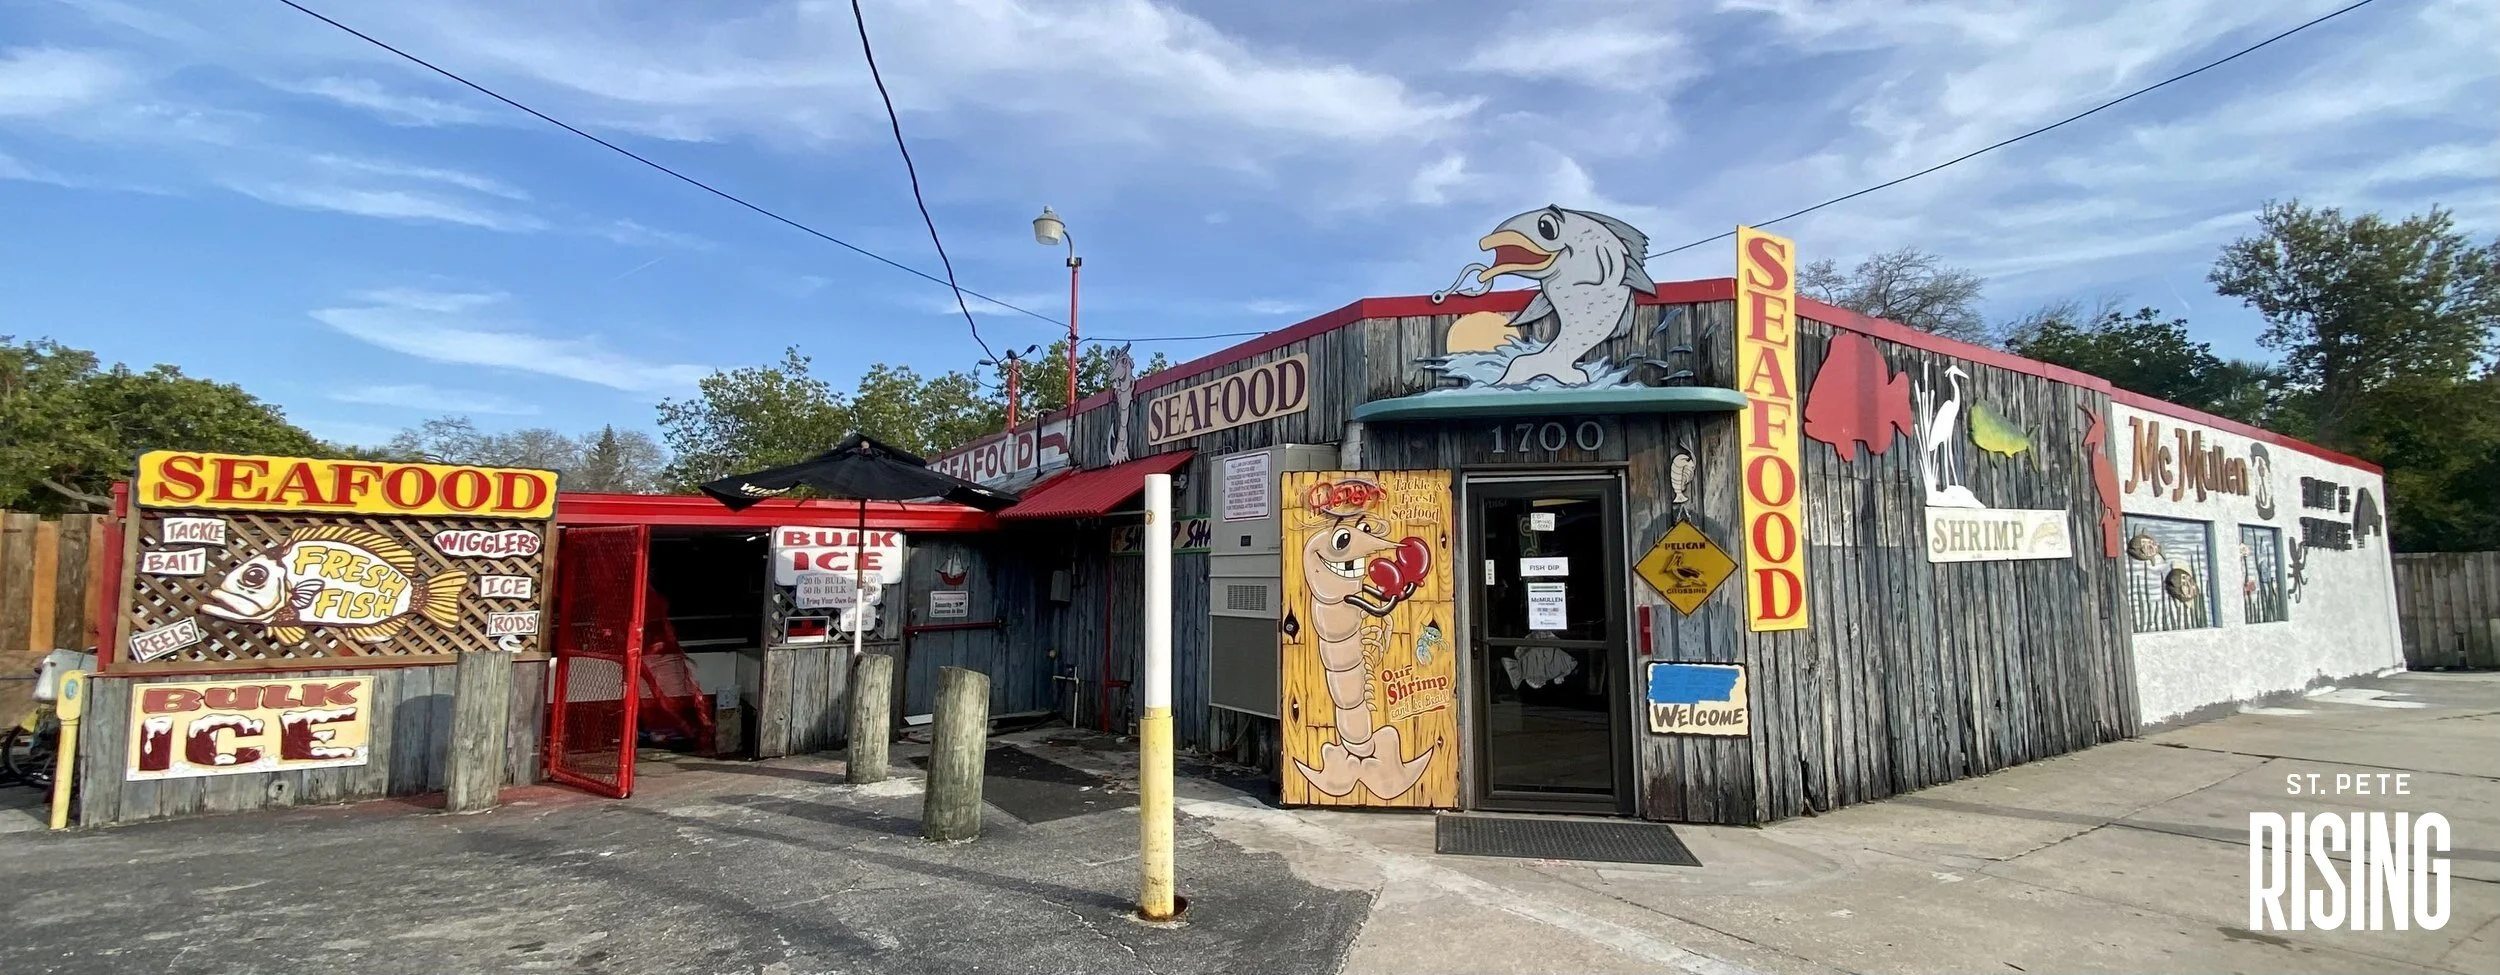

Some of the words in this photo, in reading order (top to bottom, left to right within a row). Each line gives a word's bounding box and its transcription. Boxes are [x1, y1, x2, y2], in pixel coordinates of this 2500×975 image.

[1150, 359, 1306, 442] SEAFOOD
[1492, 421, 1604, 453] 1700
[1746, 237, 1802, 621] SEAFOOD
[154, 455, 548, 513] SEAFOOD
[1394, 478, 1430, 492] Tackle
[1435, 481, 1444, 491] &
[1401, 493, 1437, 505] Fresh
[1391, 506, 1440, 523] Seafood
[166, 521, 225, 543] TACKLE
[436, 531, 539, 555] WIGGLERS
[783, 531, 897, 547] BULK
[1932, 518, 2024, 553] SHRIMP
[1664, 542, 1706, 550] PELICAN
[147, 552, 203, 572] BAIT
[293, 545, 407, 597] FRESH
[793, 551, 883, 571] ICE
[484, 577, 528, 595] ICE
[825, 576, 847, 585] BULK
[825, 585, 846, 594] BULK
[313, 587, 398, 620] FISH
[493, 616, 535, 632] RODS
[137, 624, 193, 657] REELS
[1381, 667, 1413, 682] Our
[143, 681, 362, 713] BULK
[1387, 676, 1448, 705] Shrimp
[139, 706, 357, 772] ICE
